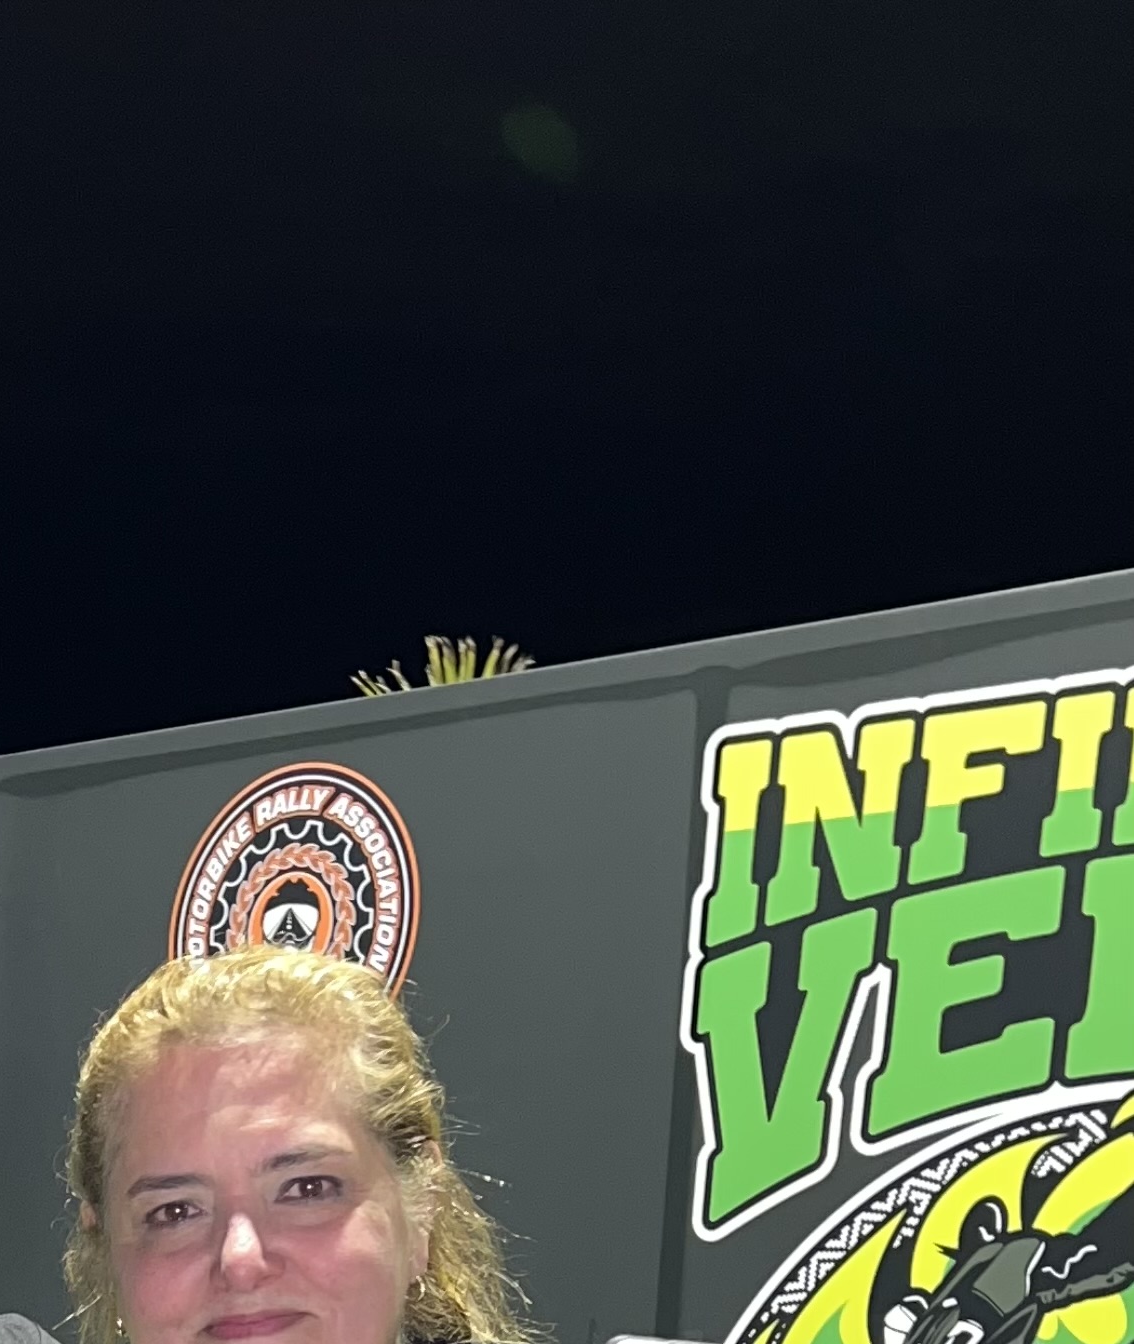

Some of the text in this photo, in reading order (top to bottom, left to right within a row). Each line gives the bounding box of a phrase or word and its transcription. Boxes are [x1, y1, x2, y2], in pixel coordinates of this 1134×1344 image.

[187, 787, 400, 976] OTORBIKE RALLY ASSOCIATION
[705, 686, 1134, 948] INFI
